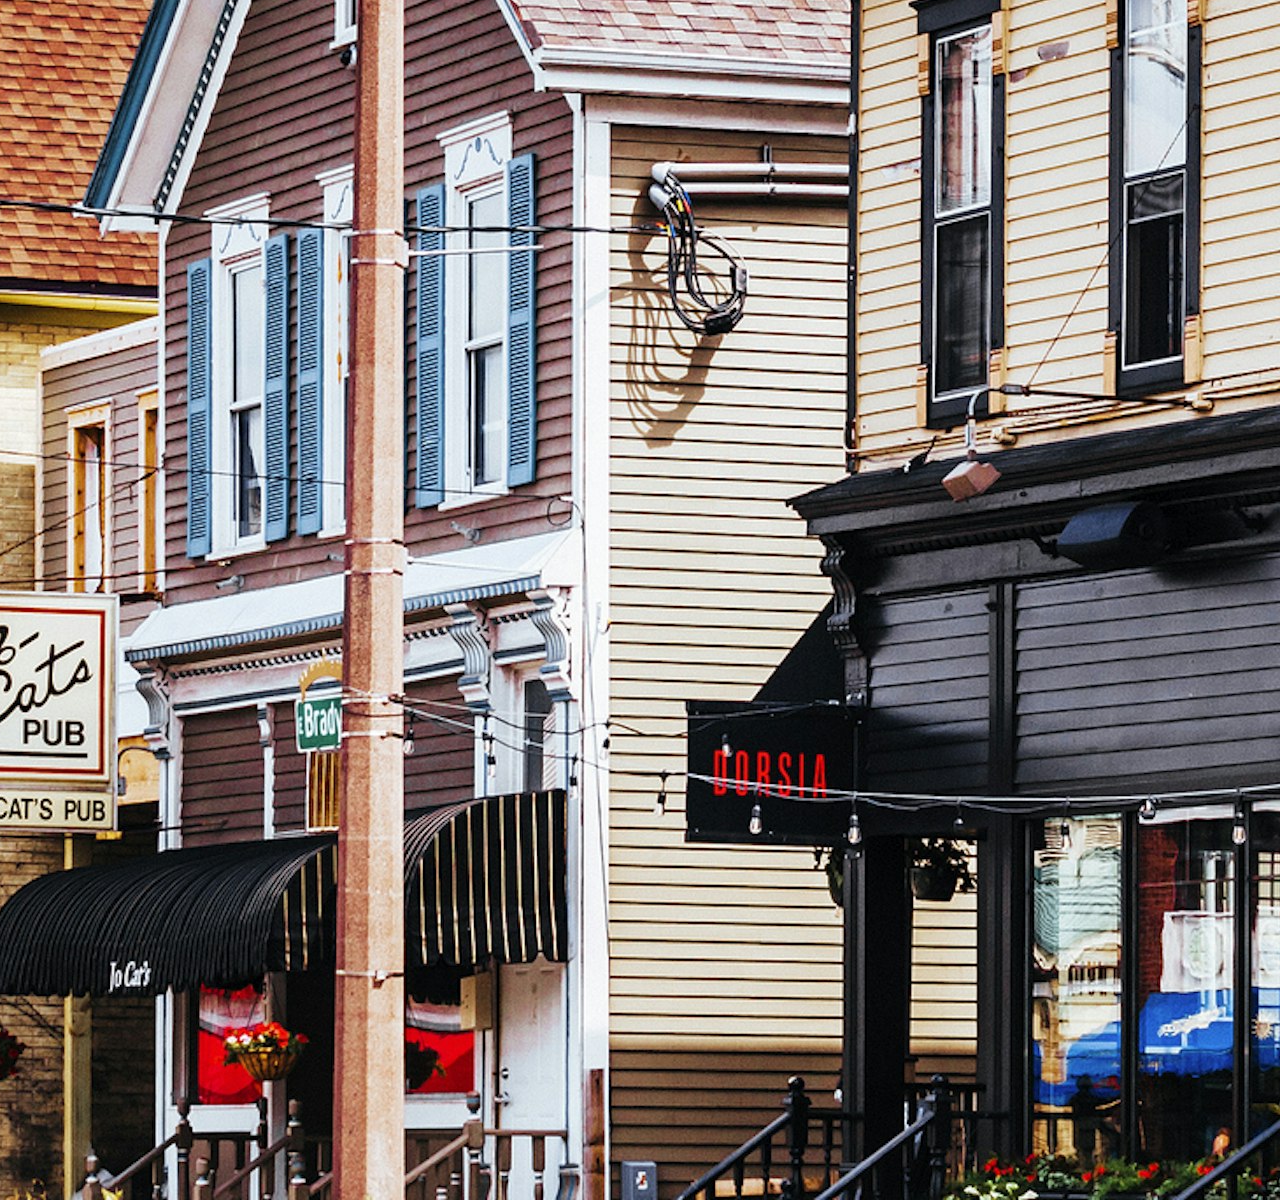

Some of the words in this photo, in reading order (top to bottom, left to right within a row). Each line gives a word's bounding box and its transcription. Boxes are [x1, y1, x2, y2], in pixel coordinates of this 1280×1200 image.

[22, 719, 85, 746] PUB
[304, 701, 343, 743] Brady
[713, 749, 827, 798] DORSIA
[64, 800, 106, 821] PUB
[108, 961, 123, 993] Jo
[124, 960, 152, 987] Cat's
